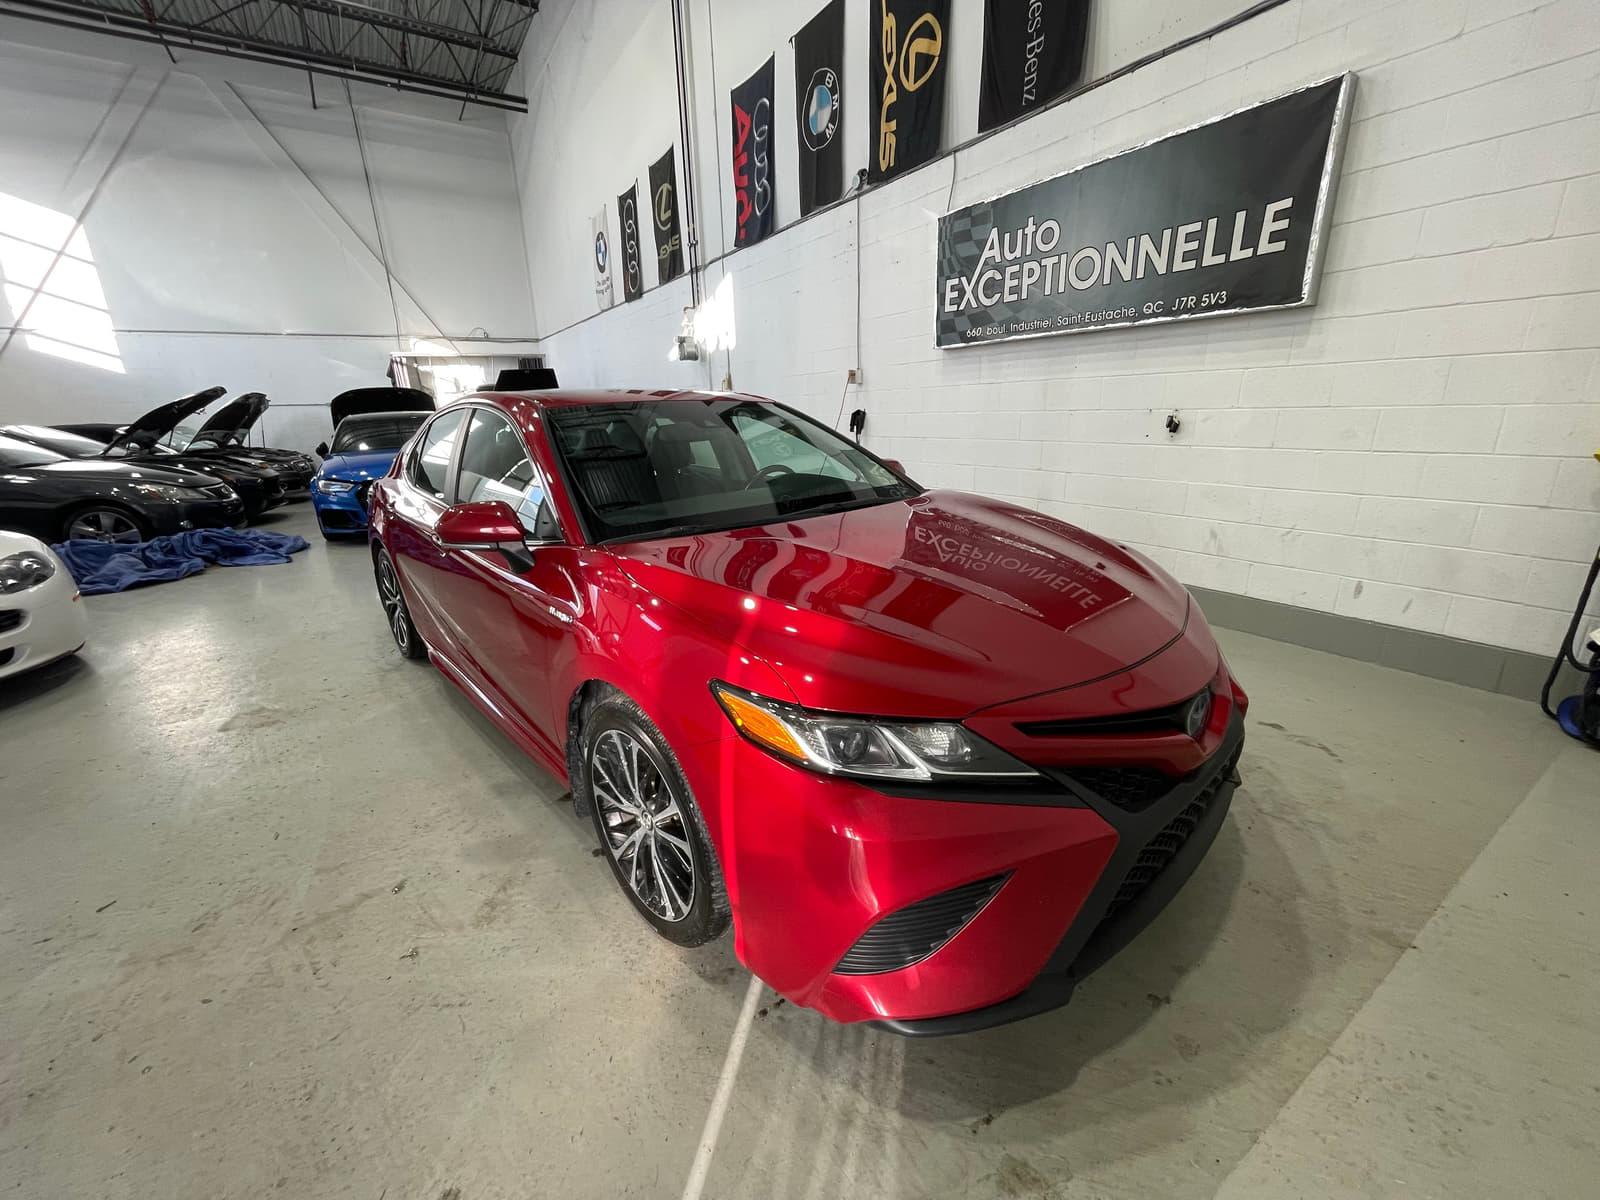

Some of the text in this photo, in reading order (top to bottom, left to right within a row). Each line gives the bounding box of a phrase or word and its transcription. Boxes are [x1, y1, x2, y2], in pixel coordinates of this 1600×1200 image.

[1022, 0, 1046, 106] es-Benz
[943, 197, 1294, 313] EXCEPTIONNELLE
[980, 215, 1061, 264] Auto
[1010, 317, 1054, 333] Industriel,
[1057, 306, 1139, 327] Saint-Eustache,
[1143, 300, 1164, 314] QC
[1171, 295, 1197, 311] J7R
[1200, 290, 1228, 307] 5V3
